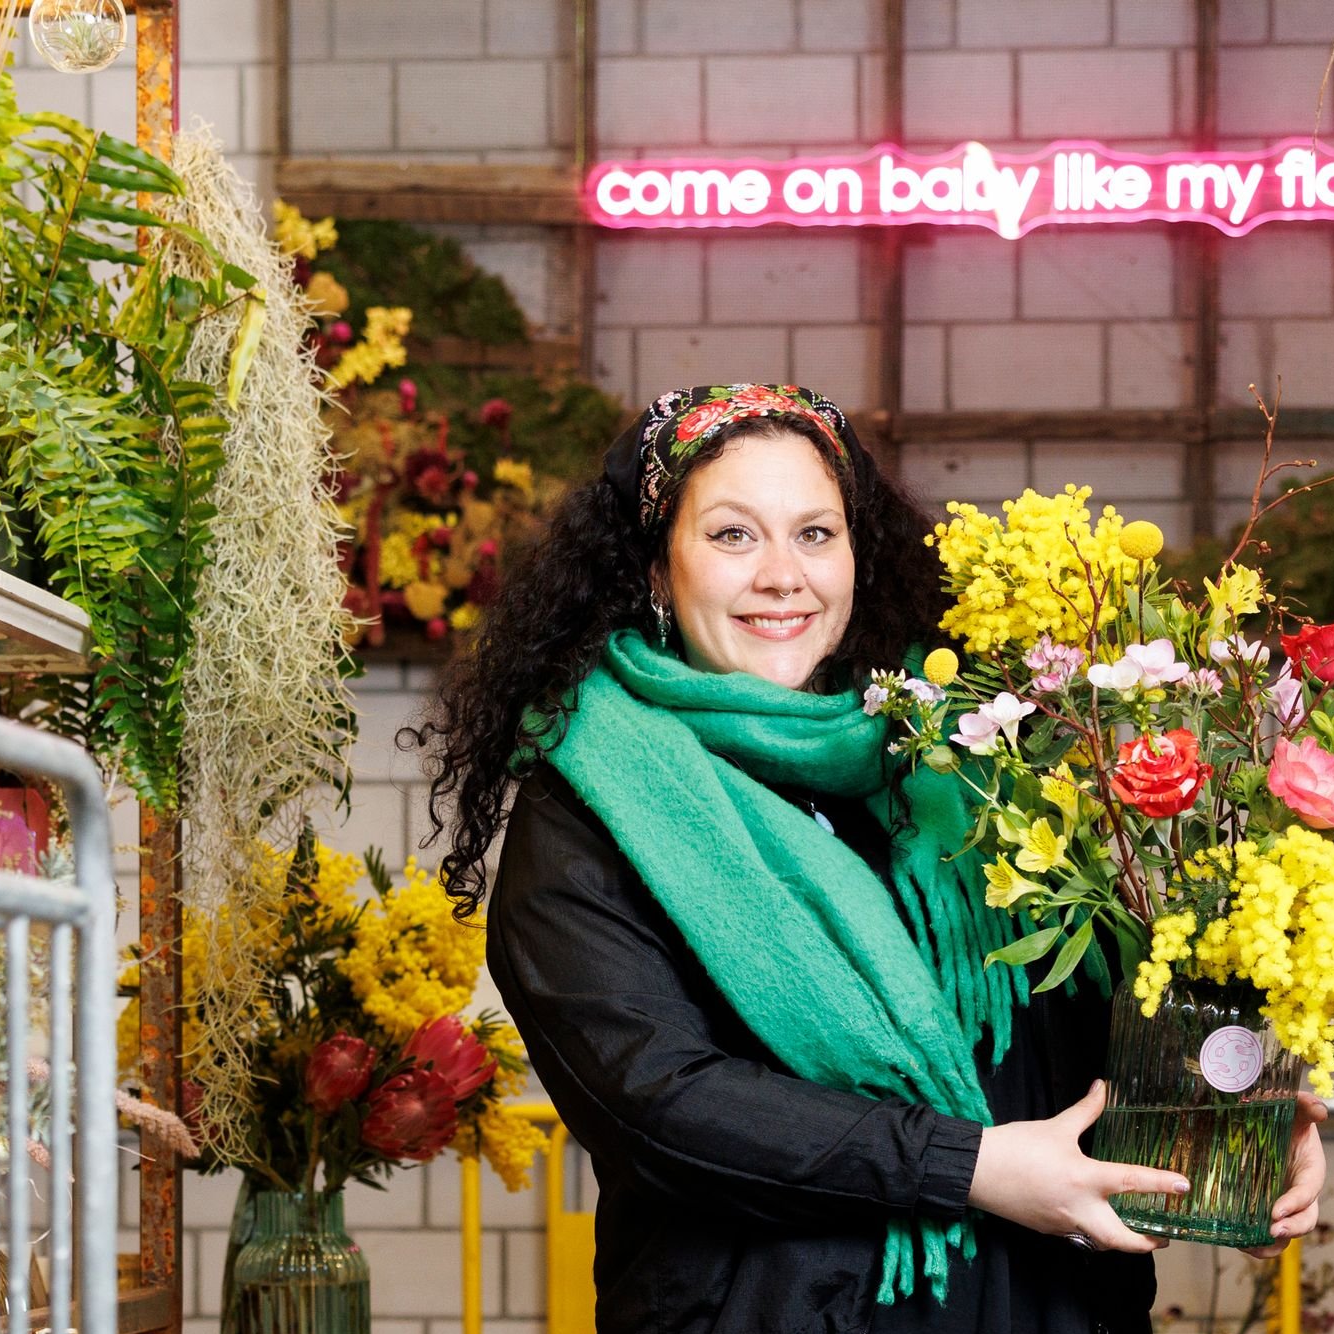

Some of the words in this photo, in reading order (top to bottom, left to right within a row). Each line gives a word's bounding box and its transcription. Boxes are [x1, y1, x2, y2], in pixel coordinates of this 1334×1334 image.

[596, 170, 771, 216] come
[782, 167, 863, 214] on
[878, 143, 1041, 240] baby
[1053, 152, 1153, 211] like
[1166, 162, 1264, 225] my
